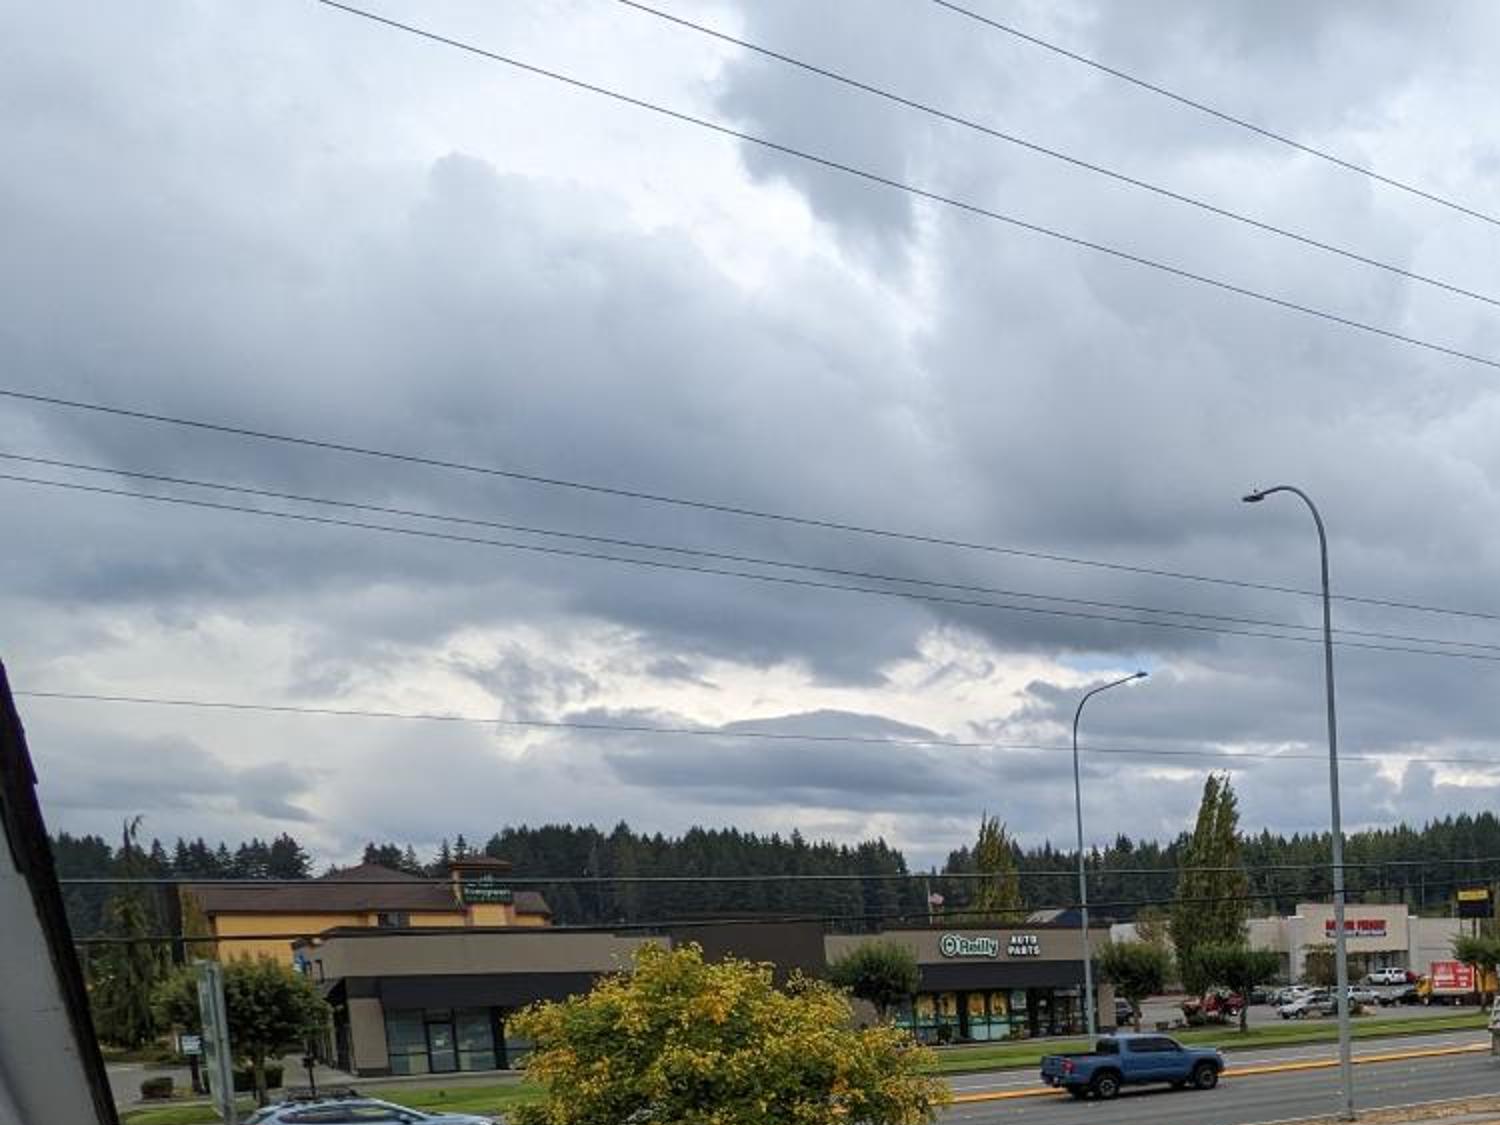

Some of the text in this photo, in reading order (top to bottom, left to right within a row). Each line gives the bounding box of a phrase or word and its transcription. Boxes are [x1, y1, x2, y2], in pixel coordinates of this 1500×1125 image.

[941, 934, 1037, 957] O'Reilly AUTO
[1007, 945, 1040, 955] PARTS
